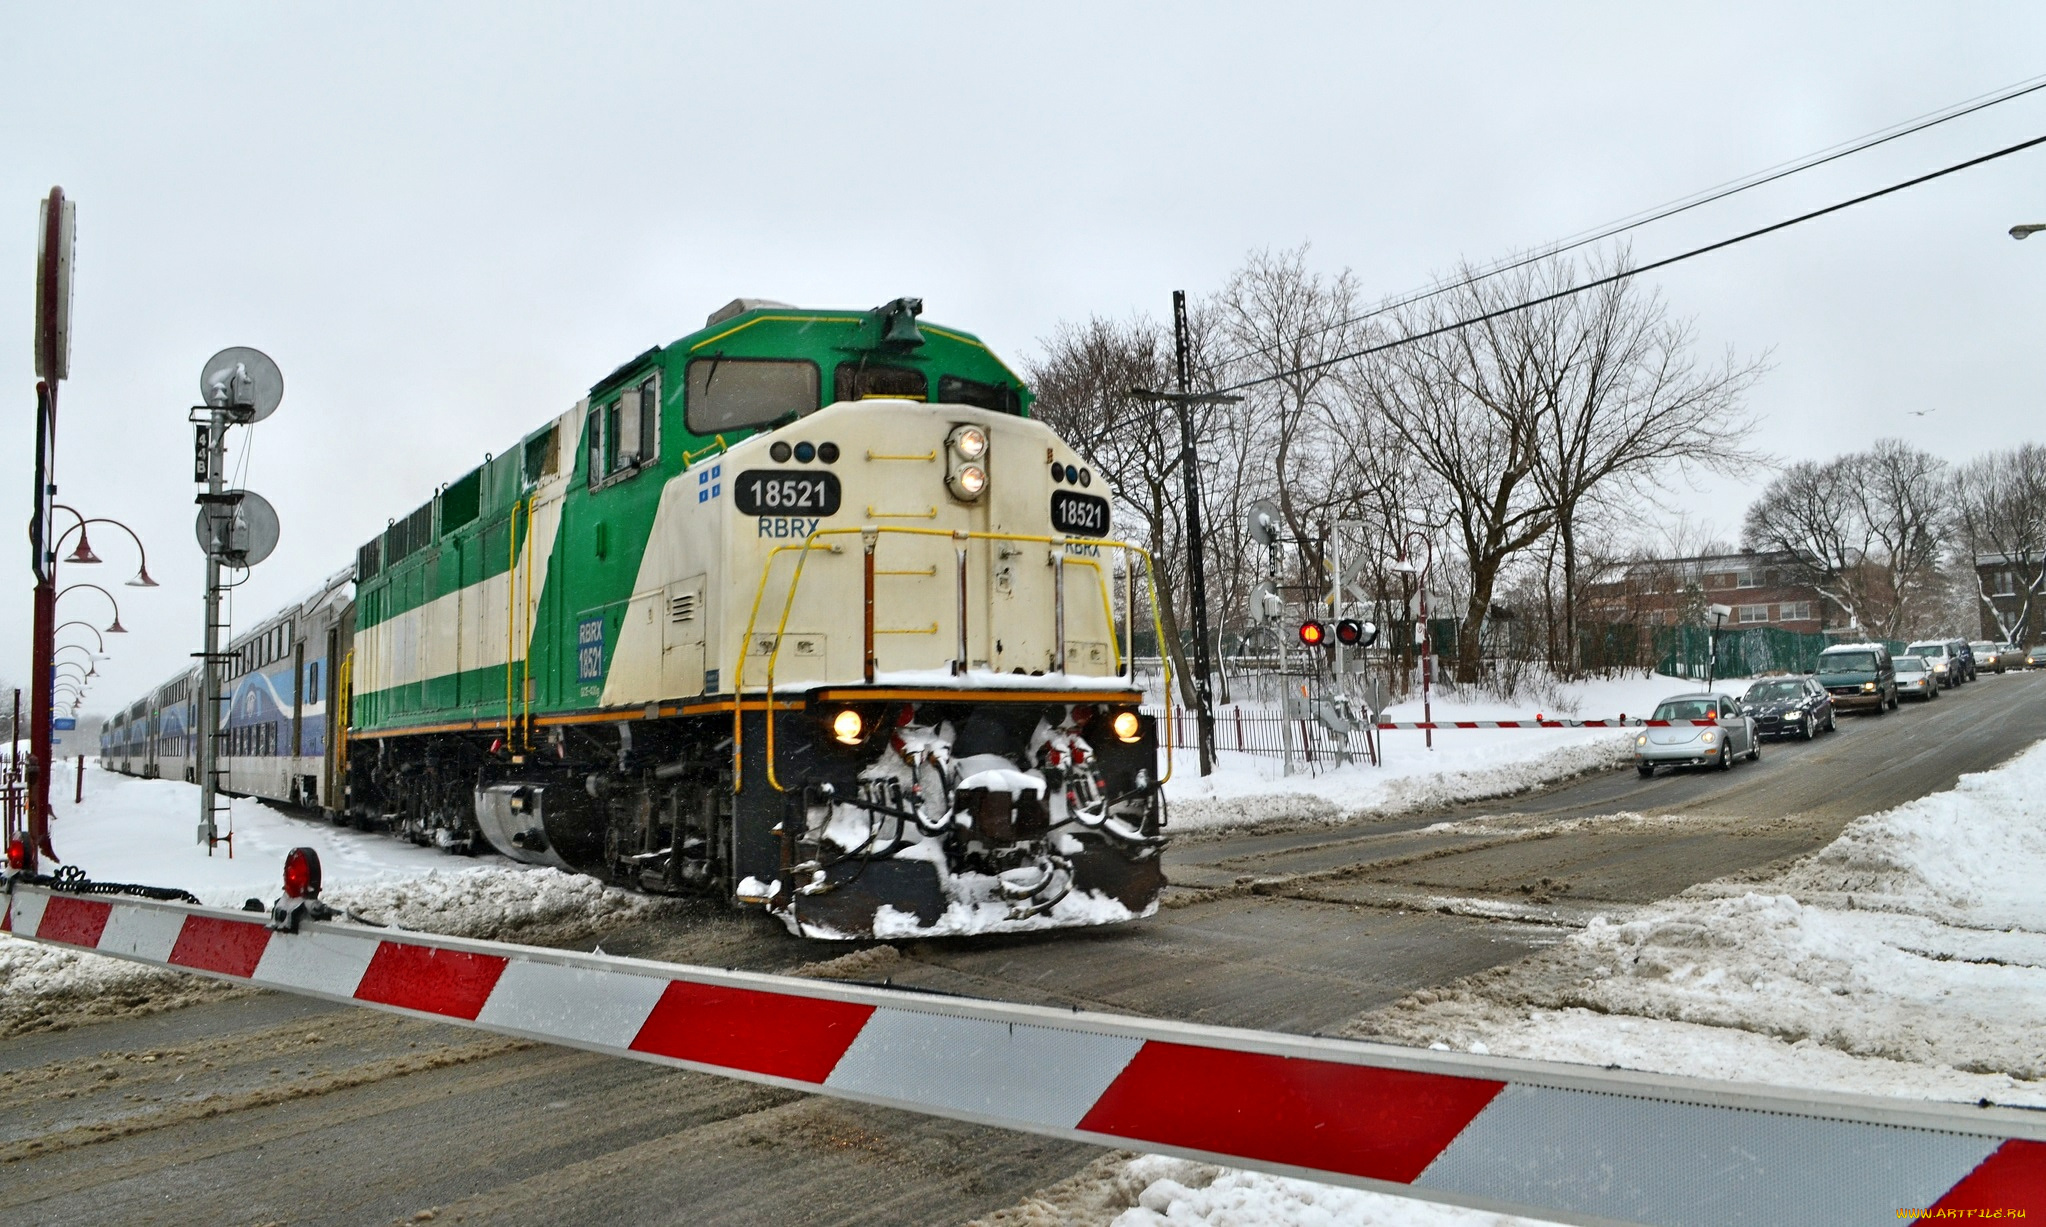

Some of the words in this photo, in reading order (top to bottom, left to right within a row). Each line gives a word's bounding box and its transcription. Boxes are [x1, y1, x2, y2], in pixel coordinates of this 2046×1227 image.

[750, 480, 825, 507] 18521
[1059, 498, 1102, 529] 18521
[758, 517, 820, 539] RBRX
[1065, 534, 1101, 558] RBRX
[579, 620, 602, 644] RBRX
[579, 645, 602, 678] 18521
